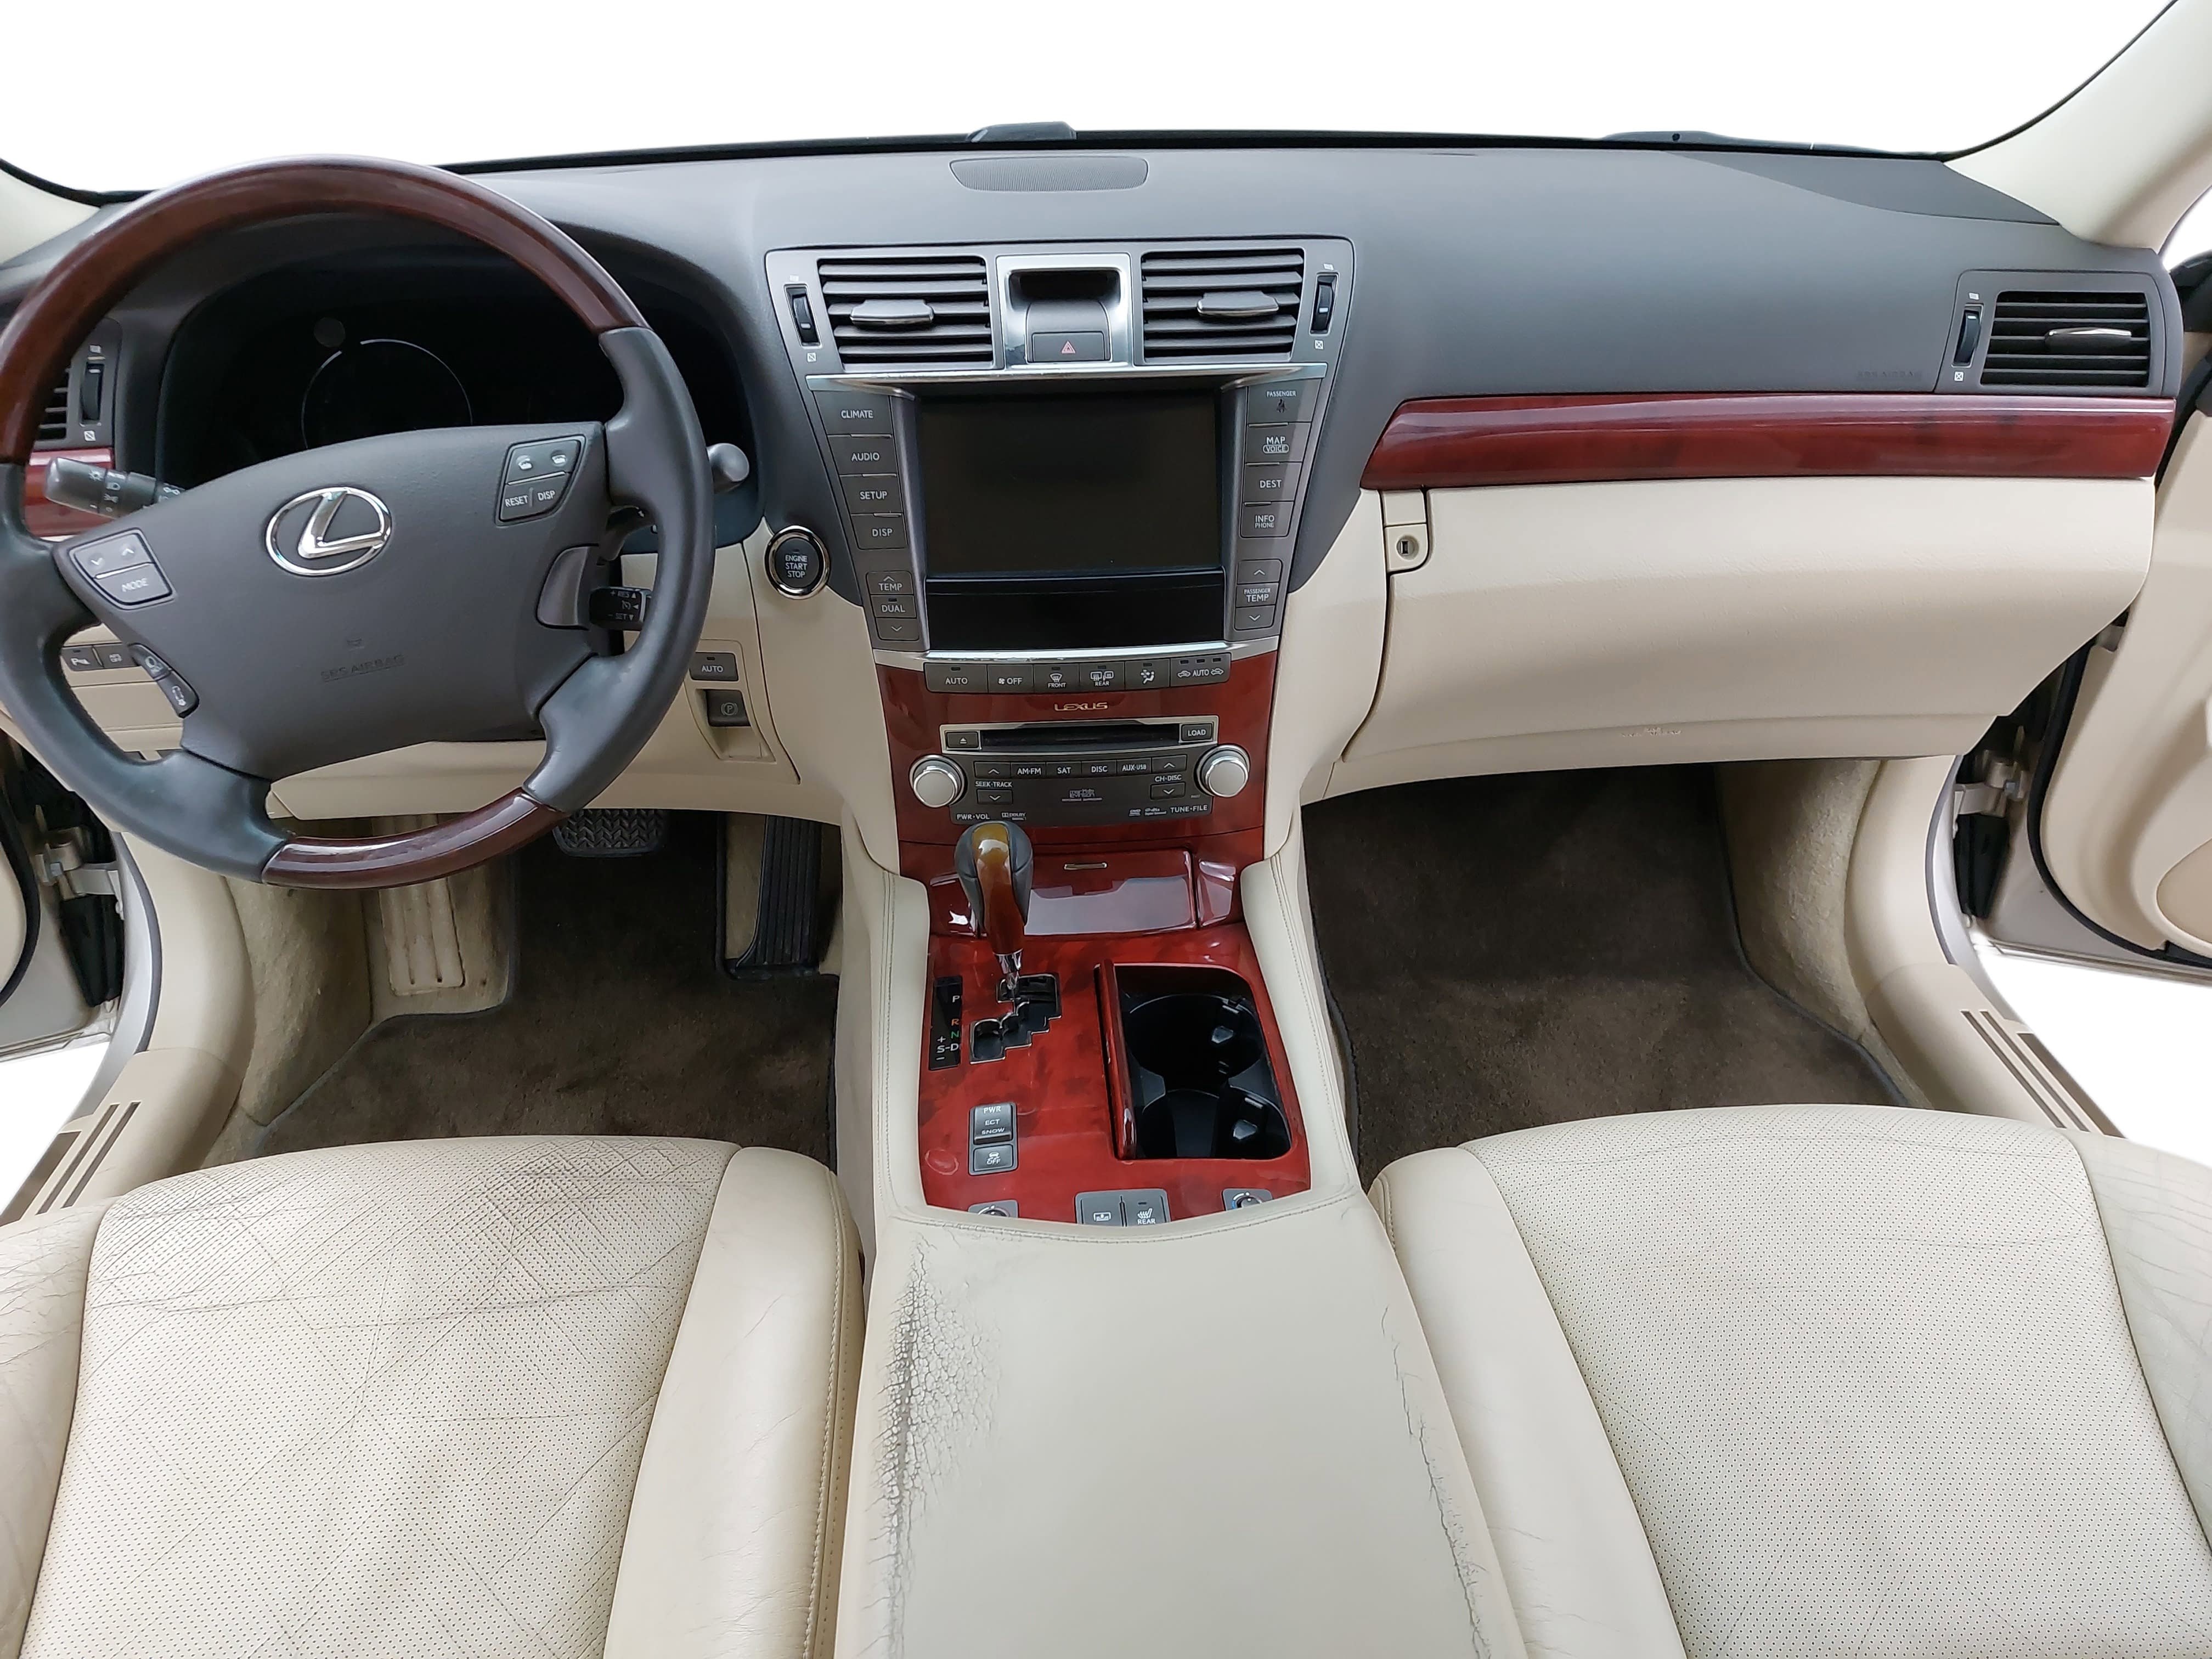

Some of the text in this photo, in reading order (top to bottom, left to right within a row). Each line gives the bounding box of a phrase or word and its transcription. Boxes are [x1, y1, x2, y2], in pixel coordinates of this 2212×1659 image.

[840, 409, 874, 419] CLIMATE
[1266, 436, 1285, 444] MAP
[851, 452, 880, 461] AUDIO
[1260, 479, 1282, 488] DEST
[504, 490, 556, 507] RESET DISP
[859, 490, 888, 500] SETUP
[872, 528, 893, 537] DISP
[785, 562, 808, 571] START
[787, 569, 805, 578] STOP
[121, 577, 149, 592] MODE
[878, 582, 903, 591] TEMP
[1246, 594, 1269, 602] TEMP
[881, 604, 906, 613] DUAL
[1006, 677, 1023, 685] OFF
[1054, 702, 1108, 711] LEXUS
[950, 1031, 959, 1039] N
[984, 1105, 1001, 1114] PWR
